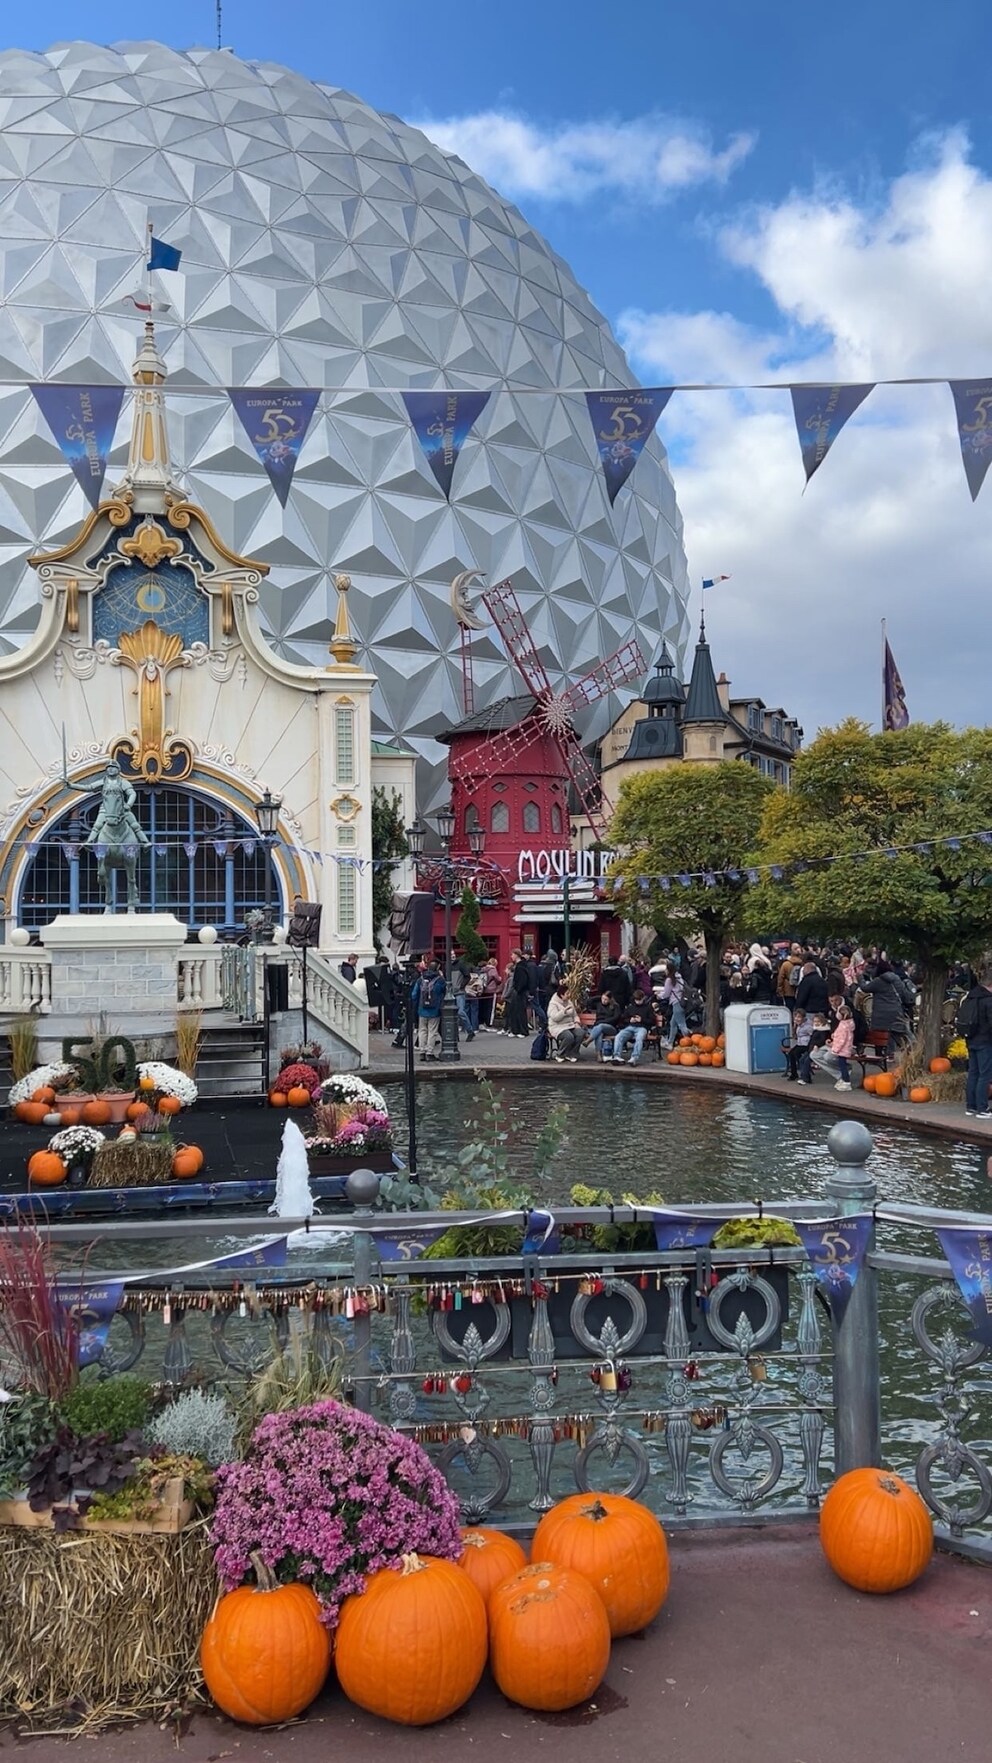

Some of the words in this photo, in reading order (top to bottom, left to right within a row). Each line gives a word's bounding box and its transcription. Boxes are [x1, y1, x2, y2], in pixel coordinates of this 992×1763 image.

[80, 392, 93, 422] PARK
[446, 397, 457, 421] PARK
[600, 396, 629, 404] EUROPA
[85, 430, 101, 476] EUROPA
[444, 426, 454, 465] EUROPA
[62, 1036, 136, 1092] 50
[978, 1234, 991, 1261] PARK
[88, 1292, 109, 1300] PARK
